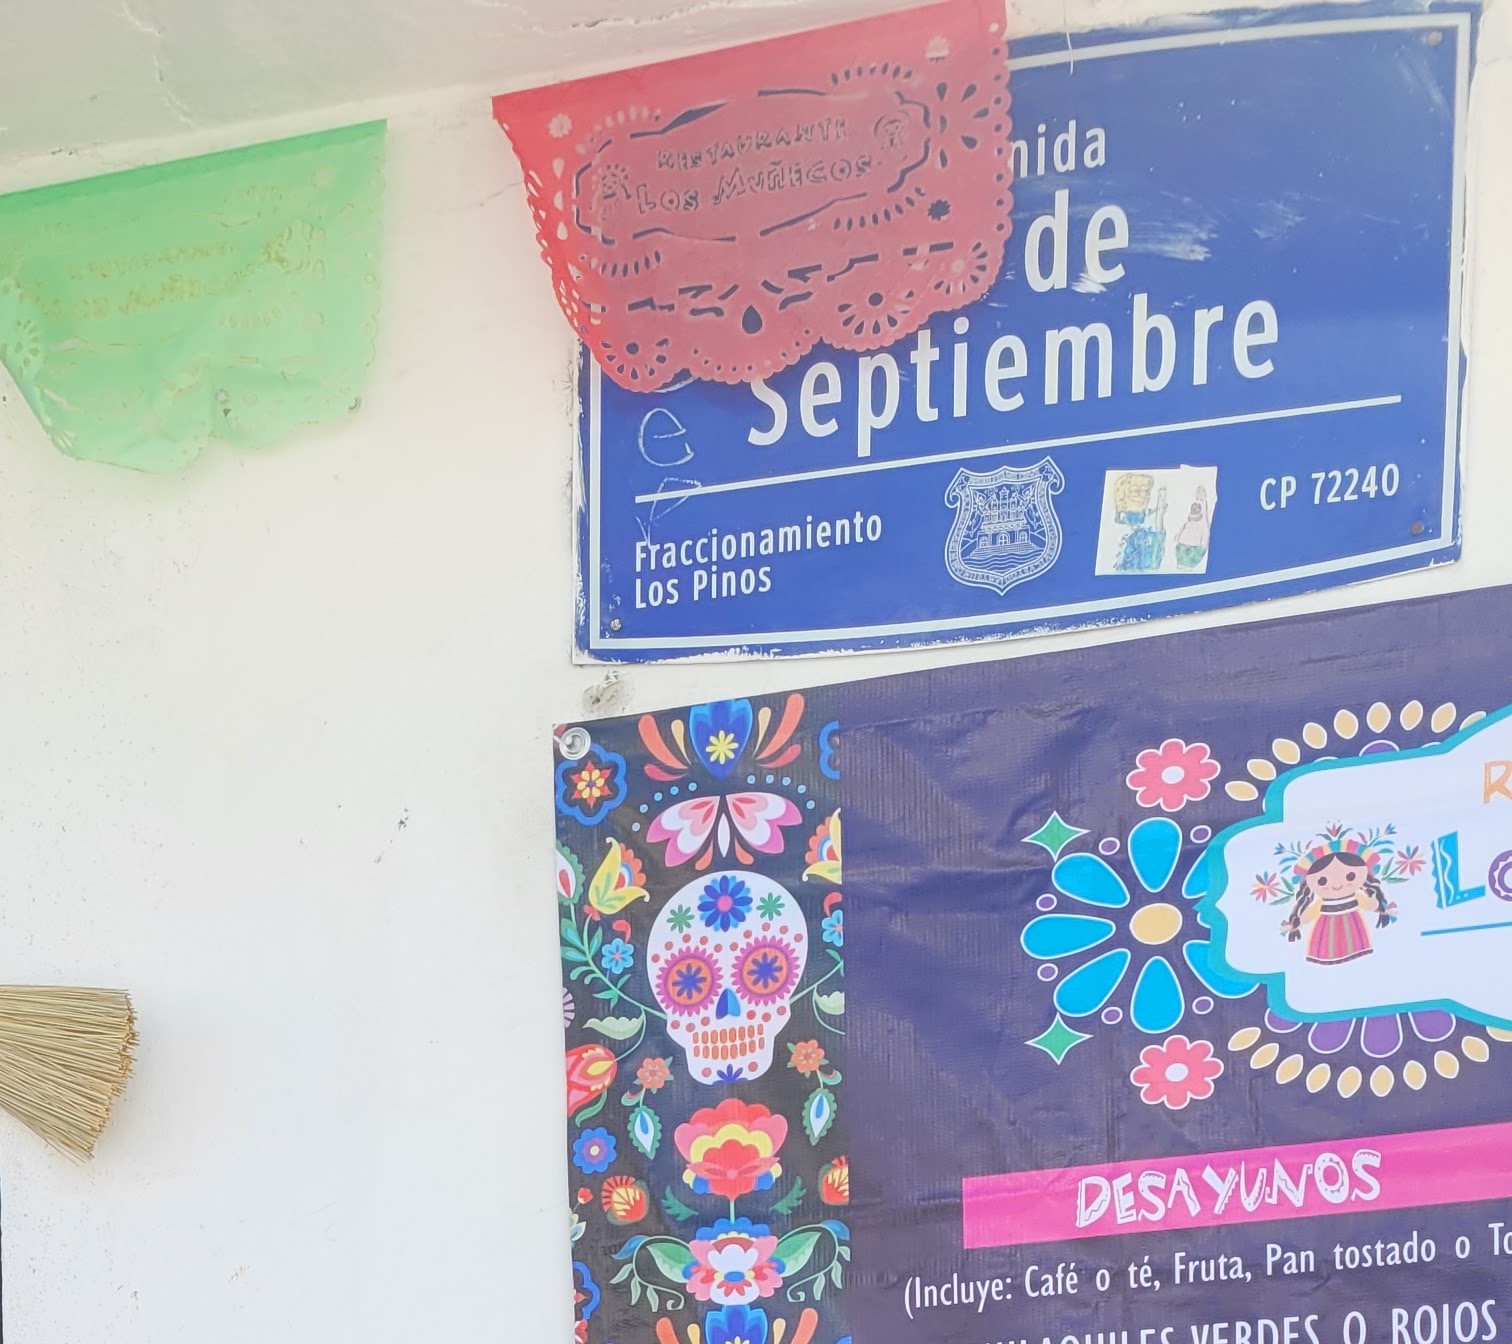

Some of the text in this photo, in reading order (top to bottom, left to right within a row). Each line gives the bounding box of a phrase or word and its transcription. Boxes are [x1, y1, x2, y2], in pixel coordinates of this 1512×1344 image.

[1009, 119, 1106, 178] nida
[637, 184, 699, 214] LOS
[1024, 188, 1129, 293] de
[747, 292, 1281, 458] Septiembre
[1259, 463, 1399, 512] CP 72240
[635, 512, 883, 572] Fraccionamiento
[635, 565, 771, 609] Los Pinos
[1075, 1148, 1382, 1228] DESAYUNOS
[904, 1272, 1013, 1320] (Incluye:
[1024, 1262, 1078, 1298] Café
[1095, 1268, 1111, 1292] o
[1127, 1262, 1161, 1291] té,
[1174, 1251, 1252, 1285] Fruta,
[1266, 1243, 1315, 1276] Pan
[1332, 1230, 1436, 1270] tostado
[1455, 1235, 1471, 1259] o
